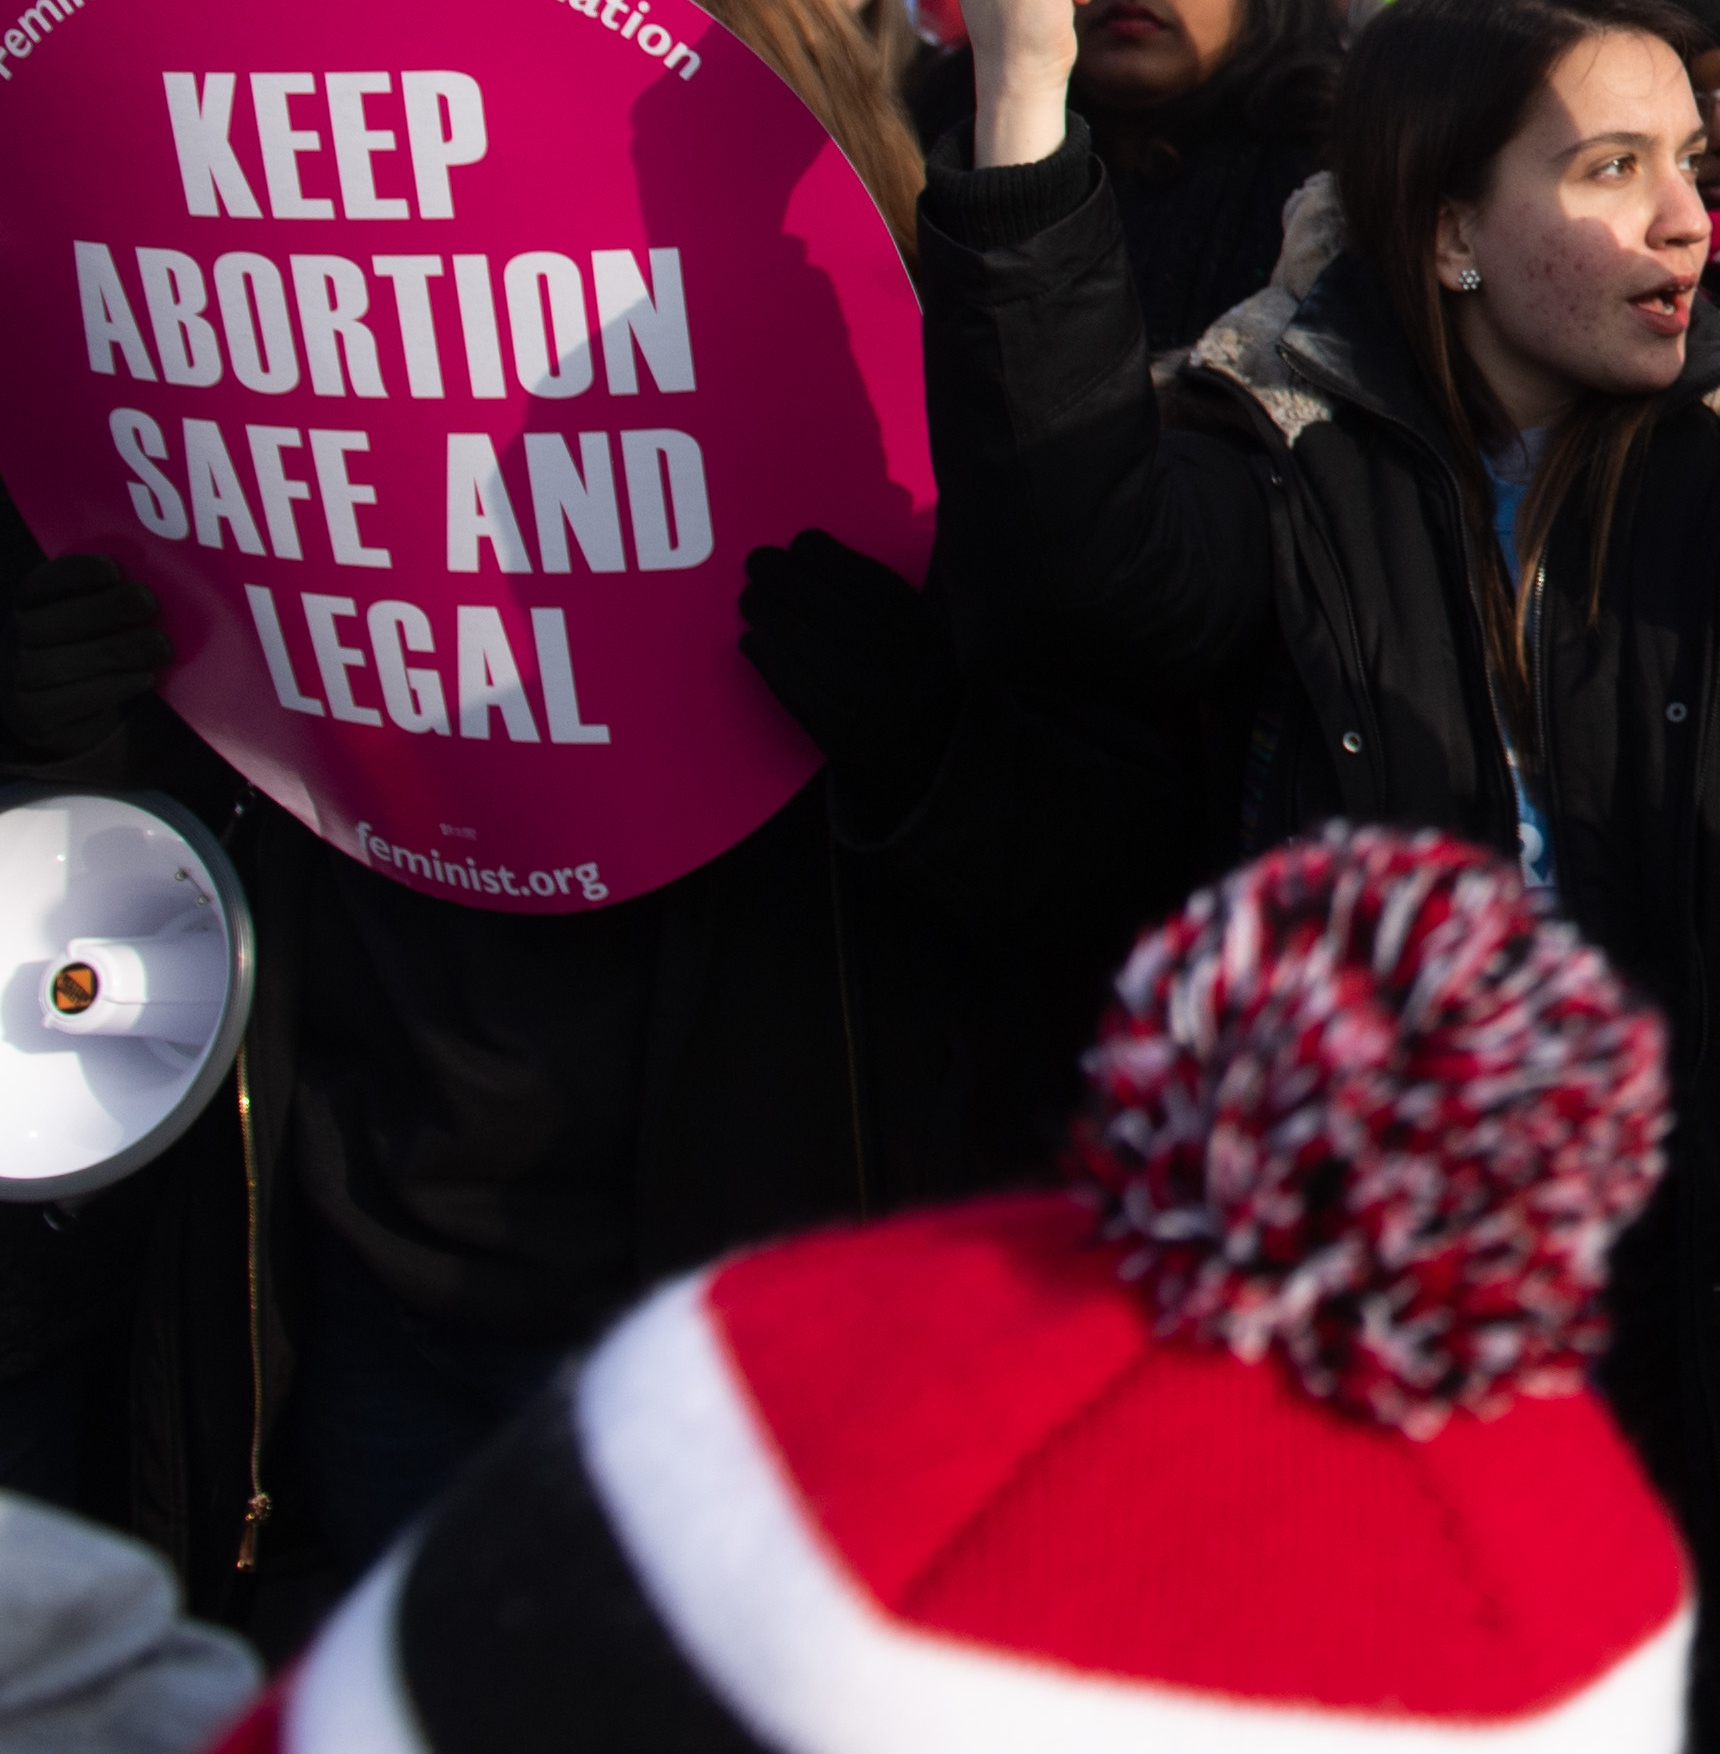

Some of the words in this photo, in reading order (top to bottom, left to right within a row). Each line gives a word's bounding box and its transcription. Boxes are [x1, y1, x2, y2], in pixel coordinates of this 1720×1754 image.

[161, 69, 490, 221] KEEP
[73, 239, 698, 400] ABORTION
[107, 407, 394, 570] SAFE
[445, 428, 716, 575] AND
[244, 582, 612, 746] LEGAL
[354, 820, 610, 902] feminist.org
